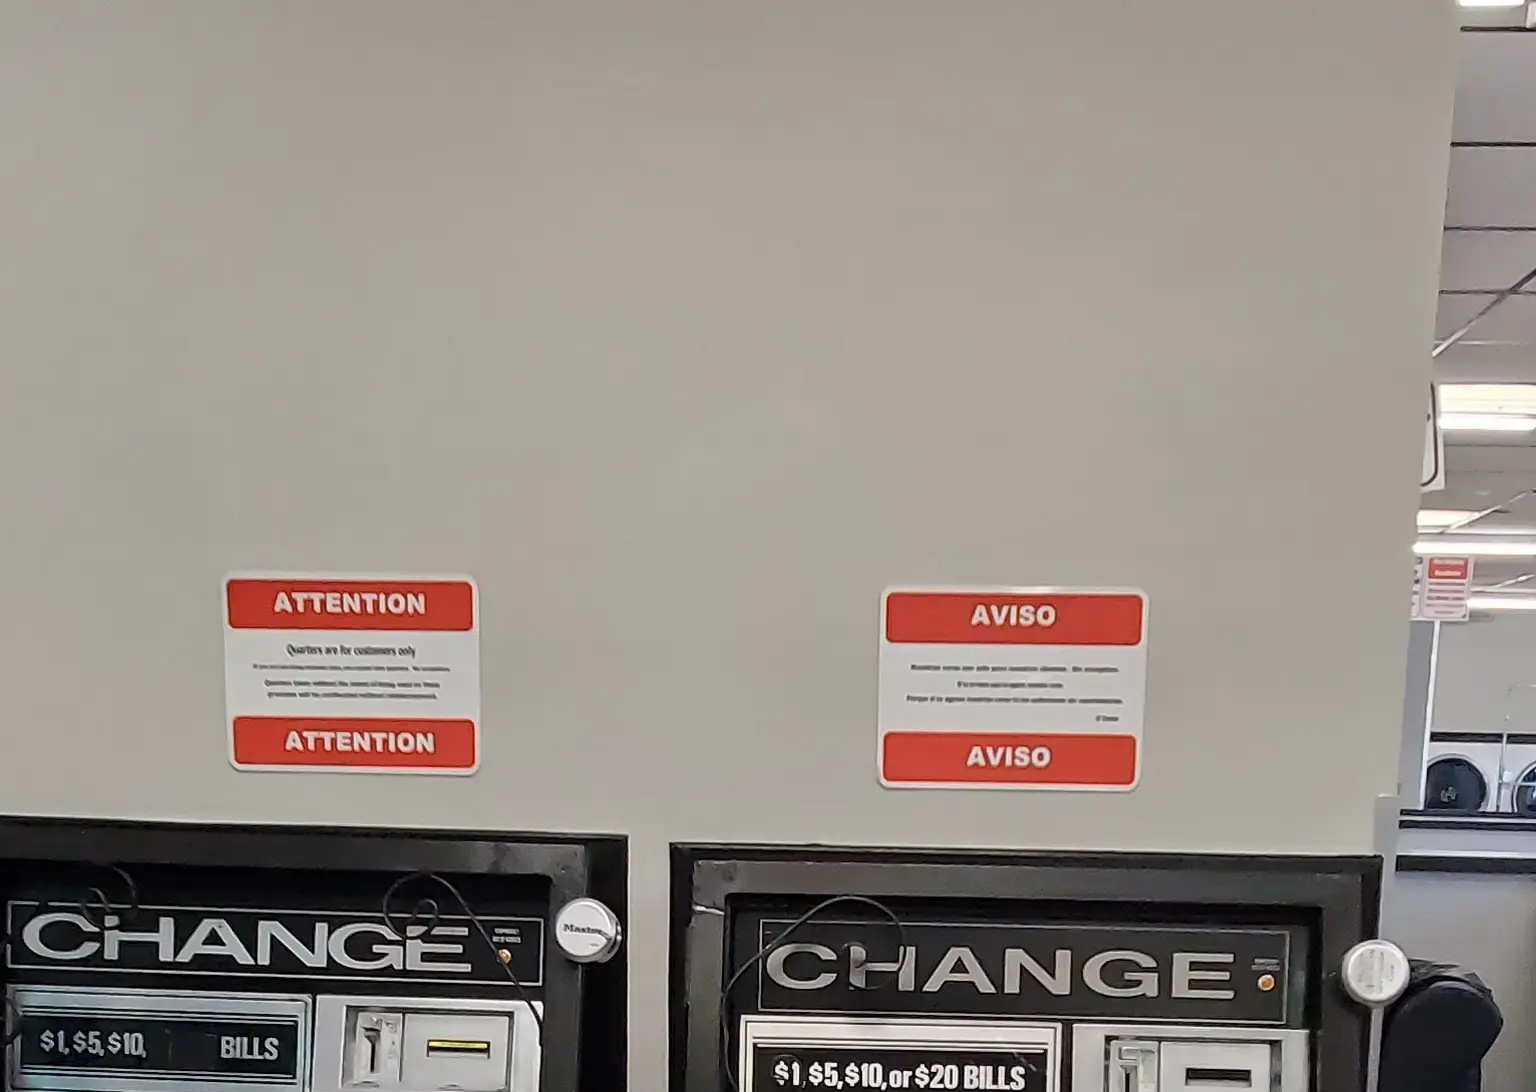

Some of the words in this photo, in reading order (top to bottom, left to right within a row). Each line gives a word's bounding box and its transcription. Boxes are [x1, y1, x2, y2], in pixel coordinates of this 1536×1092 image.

[273, 591, 427, 617] ATTENTION
[970, 604, 1057, 627] AVISO
[286, 643, 322, 657] Quarters
[324, 646, 338, 655] are
[340, 643, 352, 656] for
[398, 645, 416, 659] only
[284, 730, 437, 755] ATTENTION
[966, 745, 1052, 768] AVISO
[21, 911, 474, 973] CHANGE
[765, 942, 1236, 1001] CHANGE
[219, 1035, 280, 1062] BILLS
[915, 1062, 959, 1092] $20
[962, 1064, 1026, 1092] BILLS
